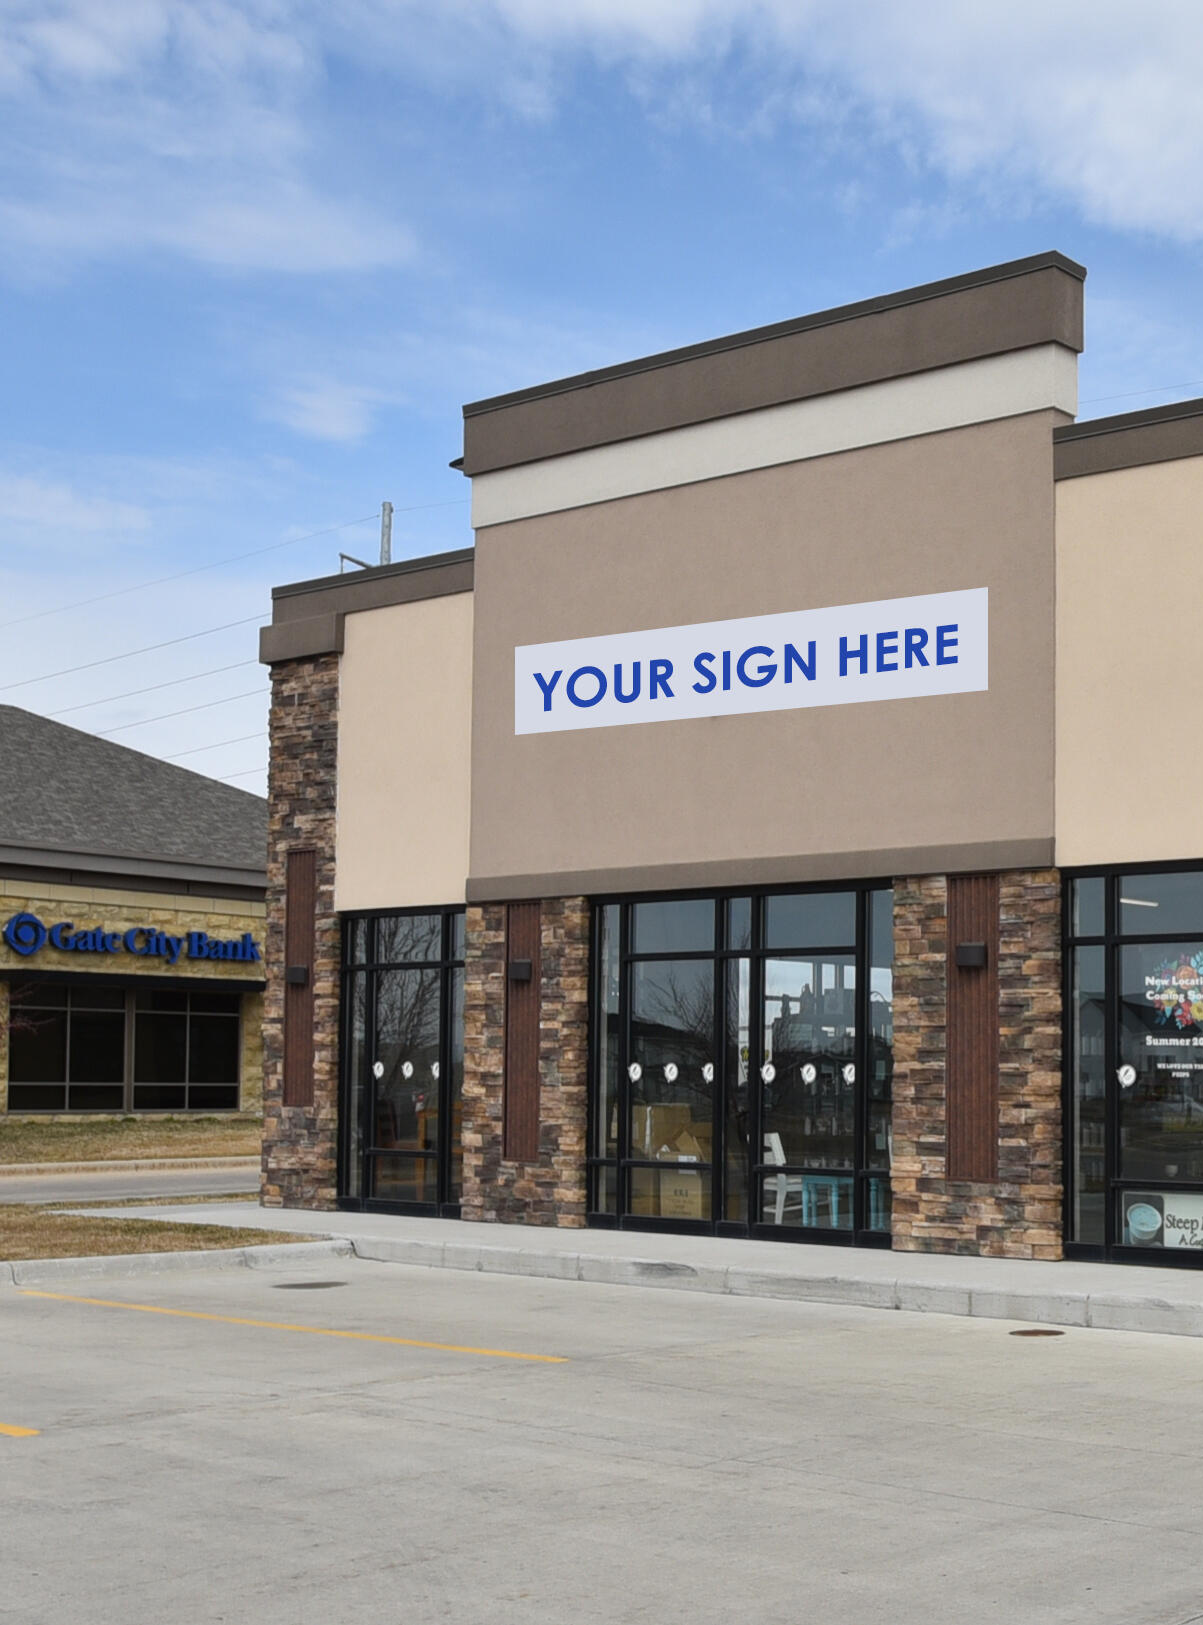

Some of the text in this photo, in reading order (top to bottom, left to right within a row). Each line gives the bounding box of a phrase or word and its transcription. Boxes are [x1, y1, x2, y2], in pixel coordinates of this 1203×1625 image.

[533, 623, 959, 712] YOUR SIGN HERE
[49, 922, 261, 964] Gate City Bank
[1145, 976, 1170, 986] New
[1146, 990, 1185, 1003] Coming
[1145, 1036, 1190, 1046] Summer
[1165, 1214, 1199, 1233] Steep
[1179, 1234, 1188, 1246] A
